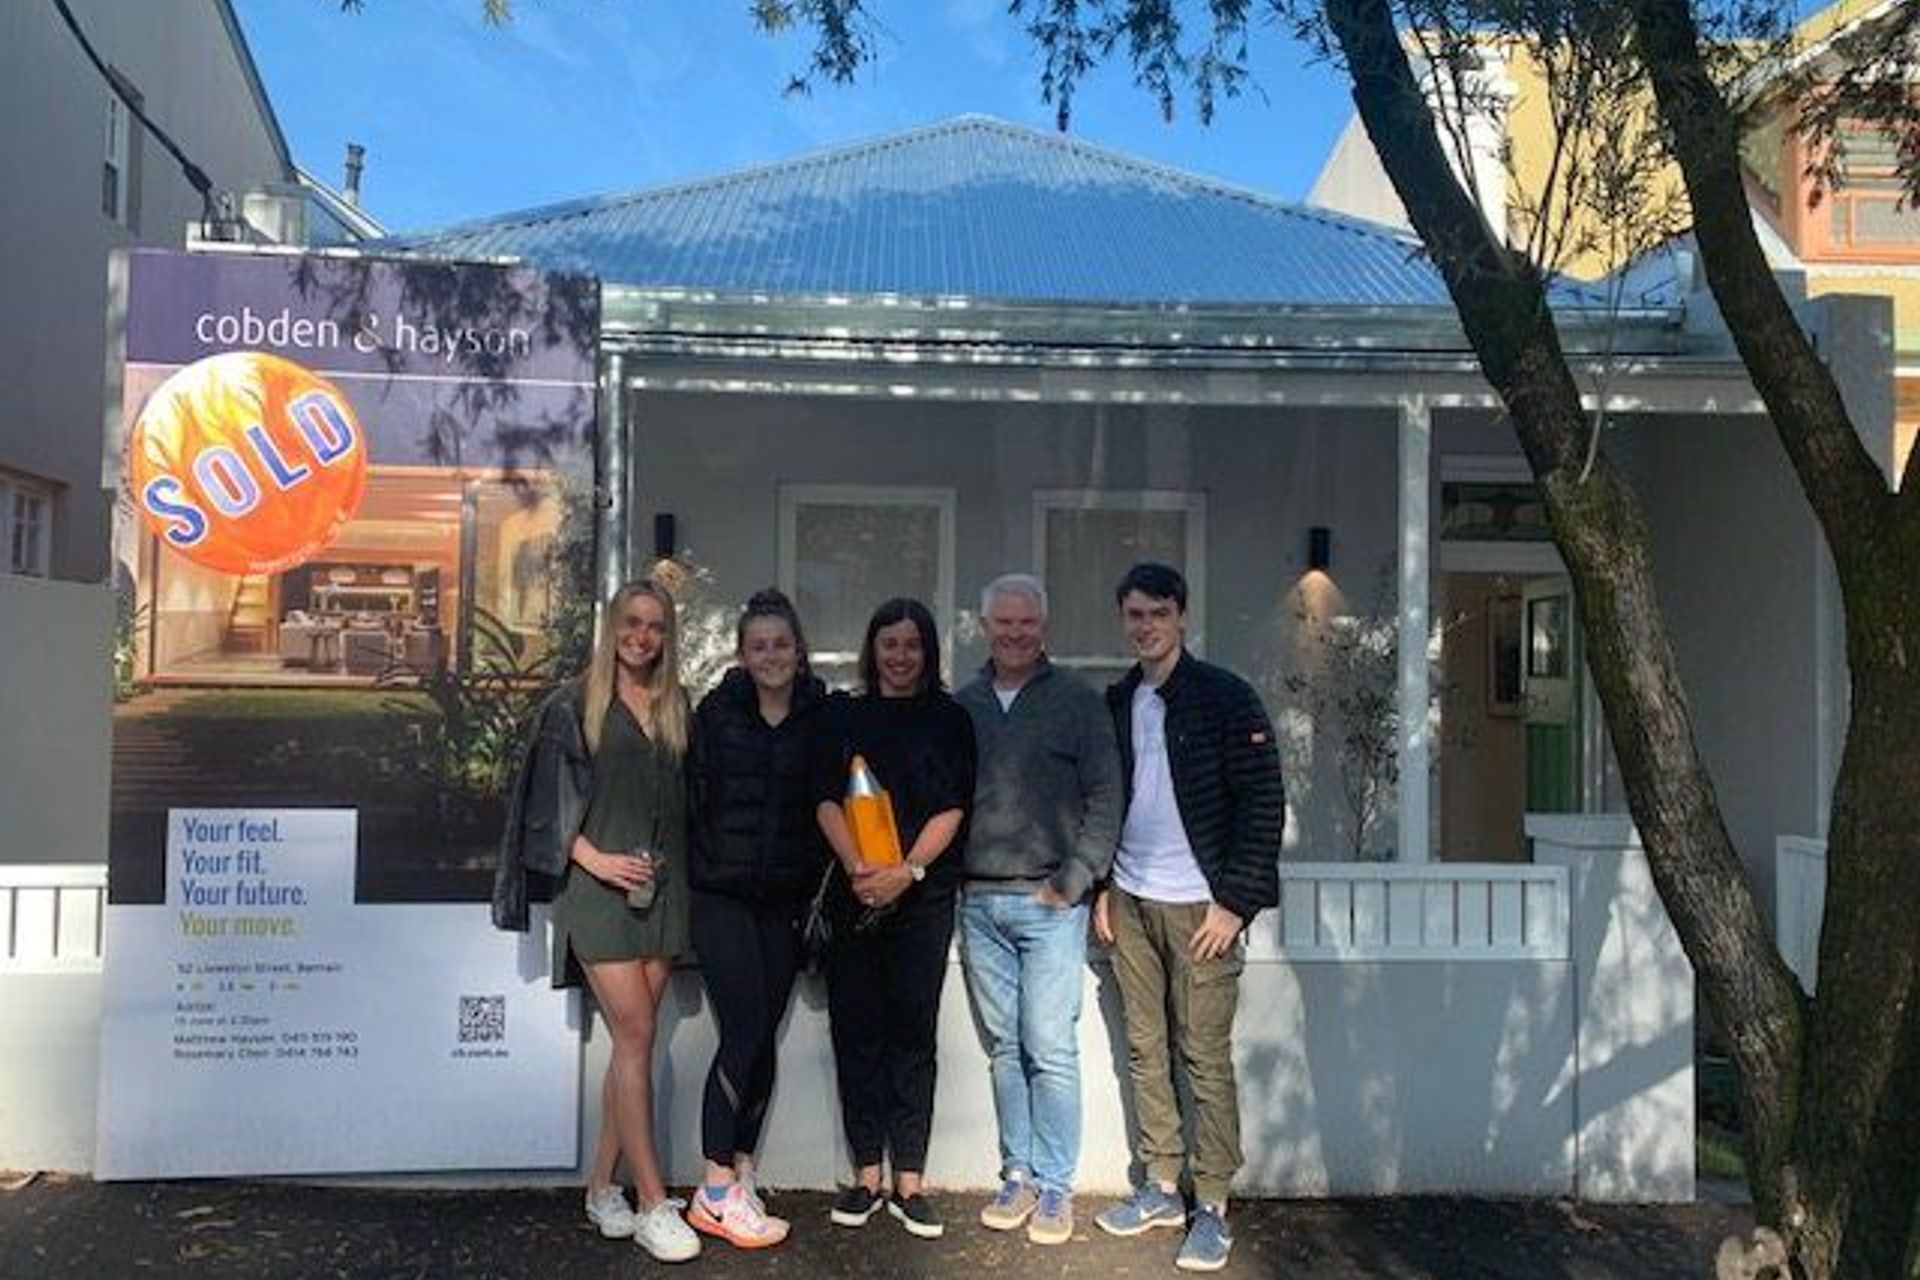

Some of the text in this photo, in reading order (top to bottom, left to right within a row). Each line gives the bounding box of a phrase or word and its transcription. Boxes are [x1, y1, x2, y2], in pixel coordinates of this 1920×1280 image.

[196, 307, 531, 361] cobden & hayson
[144, 391, 353, 547] SOLD
[182, 818, 284, 842] Your feel.
[182, 849, 266, 874] Your fit.
[181, 880, 308, 905] Your future.
[180, 911, 296, 936] Your move.
